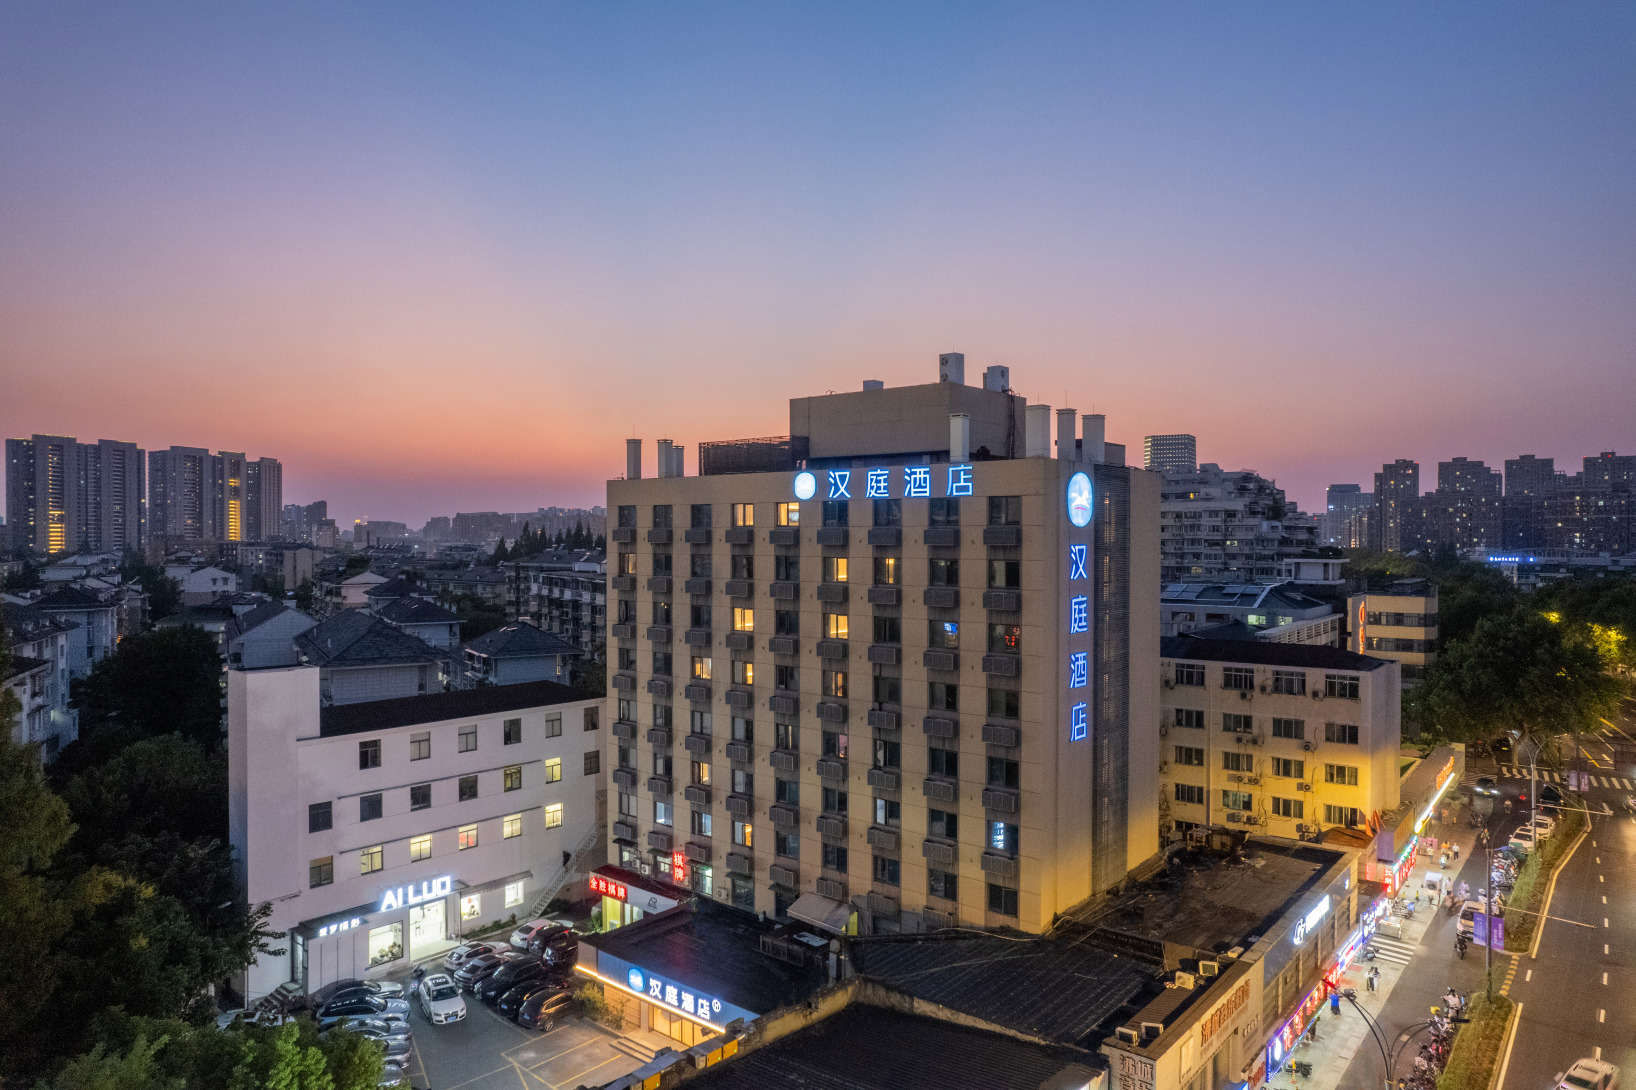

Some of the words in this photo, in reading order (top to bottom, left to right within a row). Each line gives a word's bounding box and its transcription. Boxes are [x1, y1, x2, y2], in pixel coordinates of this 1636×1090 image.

[829, 464, 973, 498] 汉庭酒店
[1069, 544, 1088, 742] 汉庭酒店
[673, 852, 684, 880] 棋牌
[381, 887, 403, 912] AI
[590, 876, 627, 899] 全胜棋牌
[649, 977, 710, 1020] 汉庭酒店
